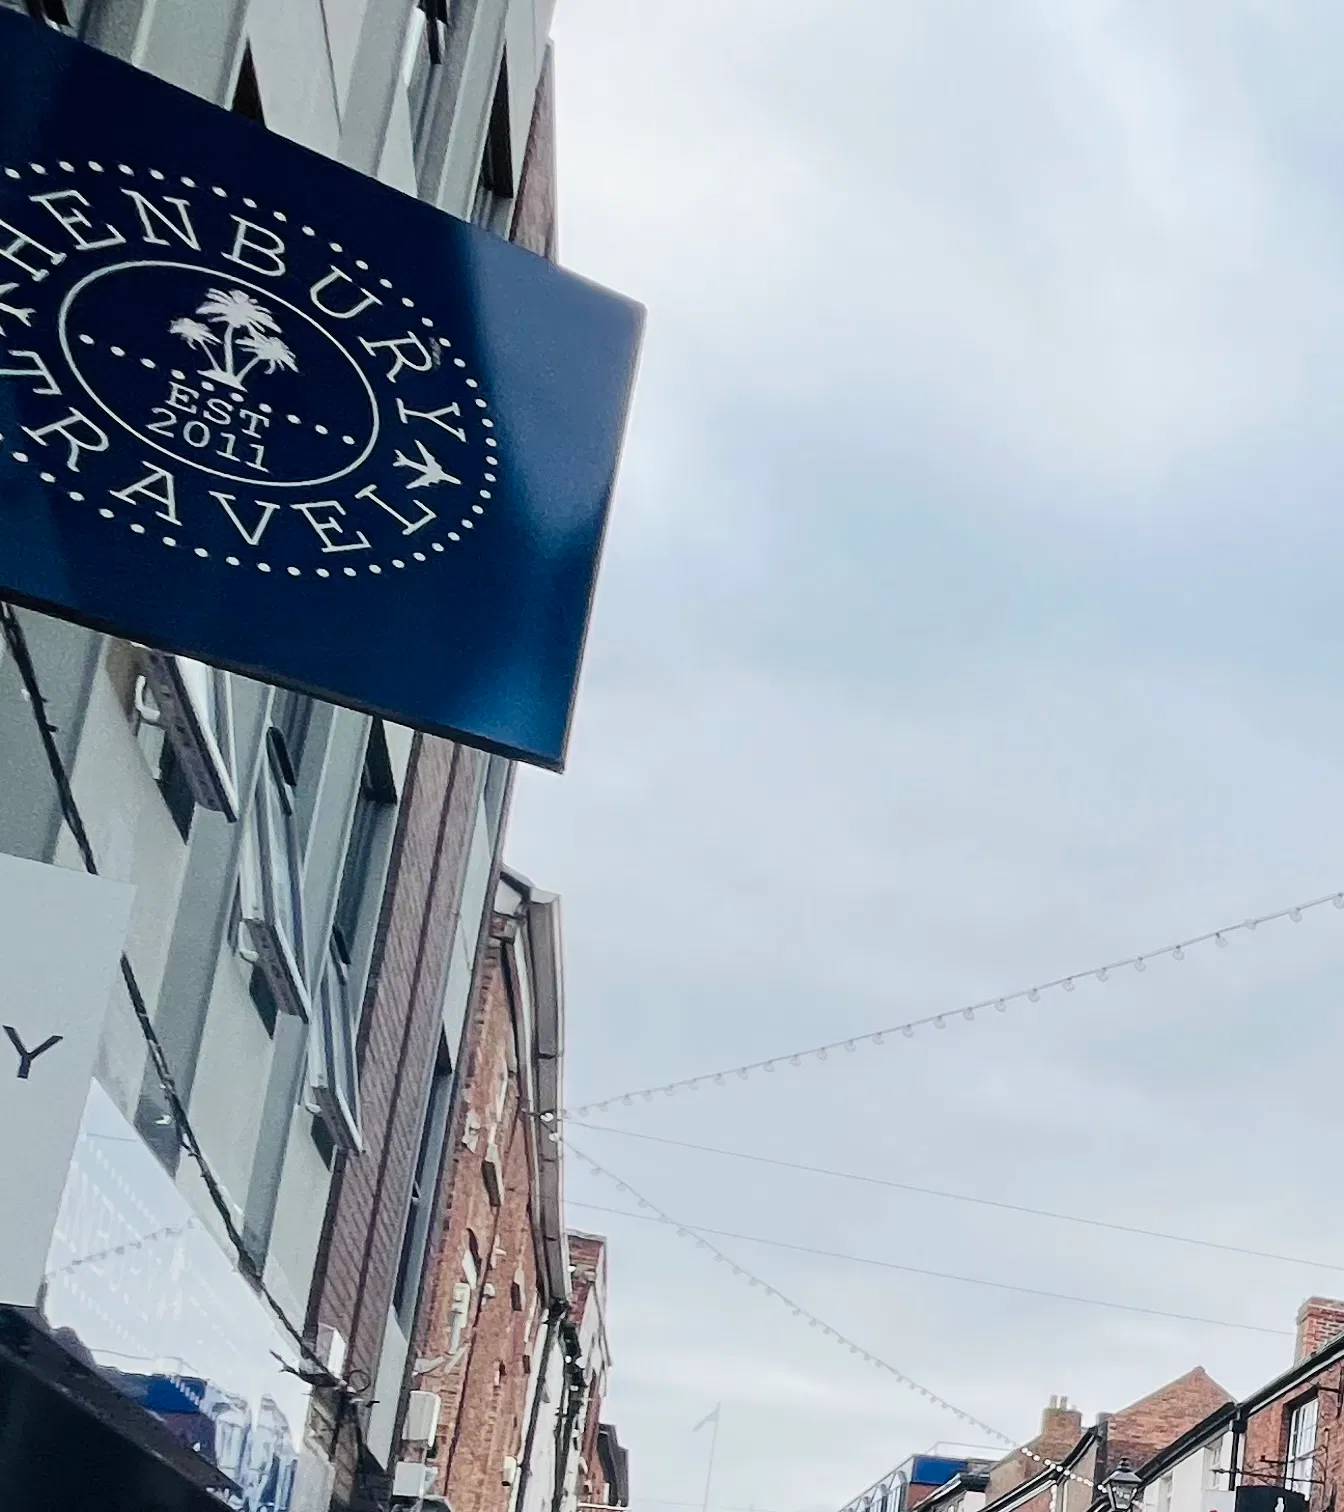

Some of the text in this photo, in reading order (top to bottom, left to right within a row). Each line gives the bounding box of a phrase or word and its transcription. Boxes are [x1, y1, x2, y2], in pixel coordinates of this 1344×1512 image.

[144, 406, 270, 474] 2011
[166, 380, 271, 437] EST
[0, 350, 437, 553] TRAVEL
